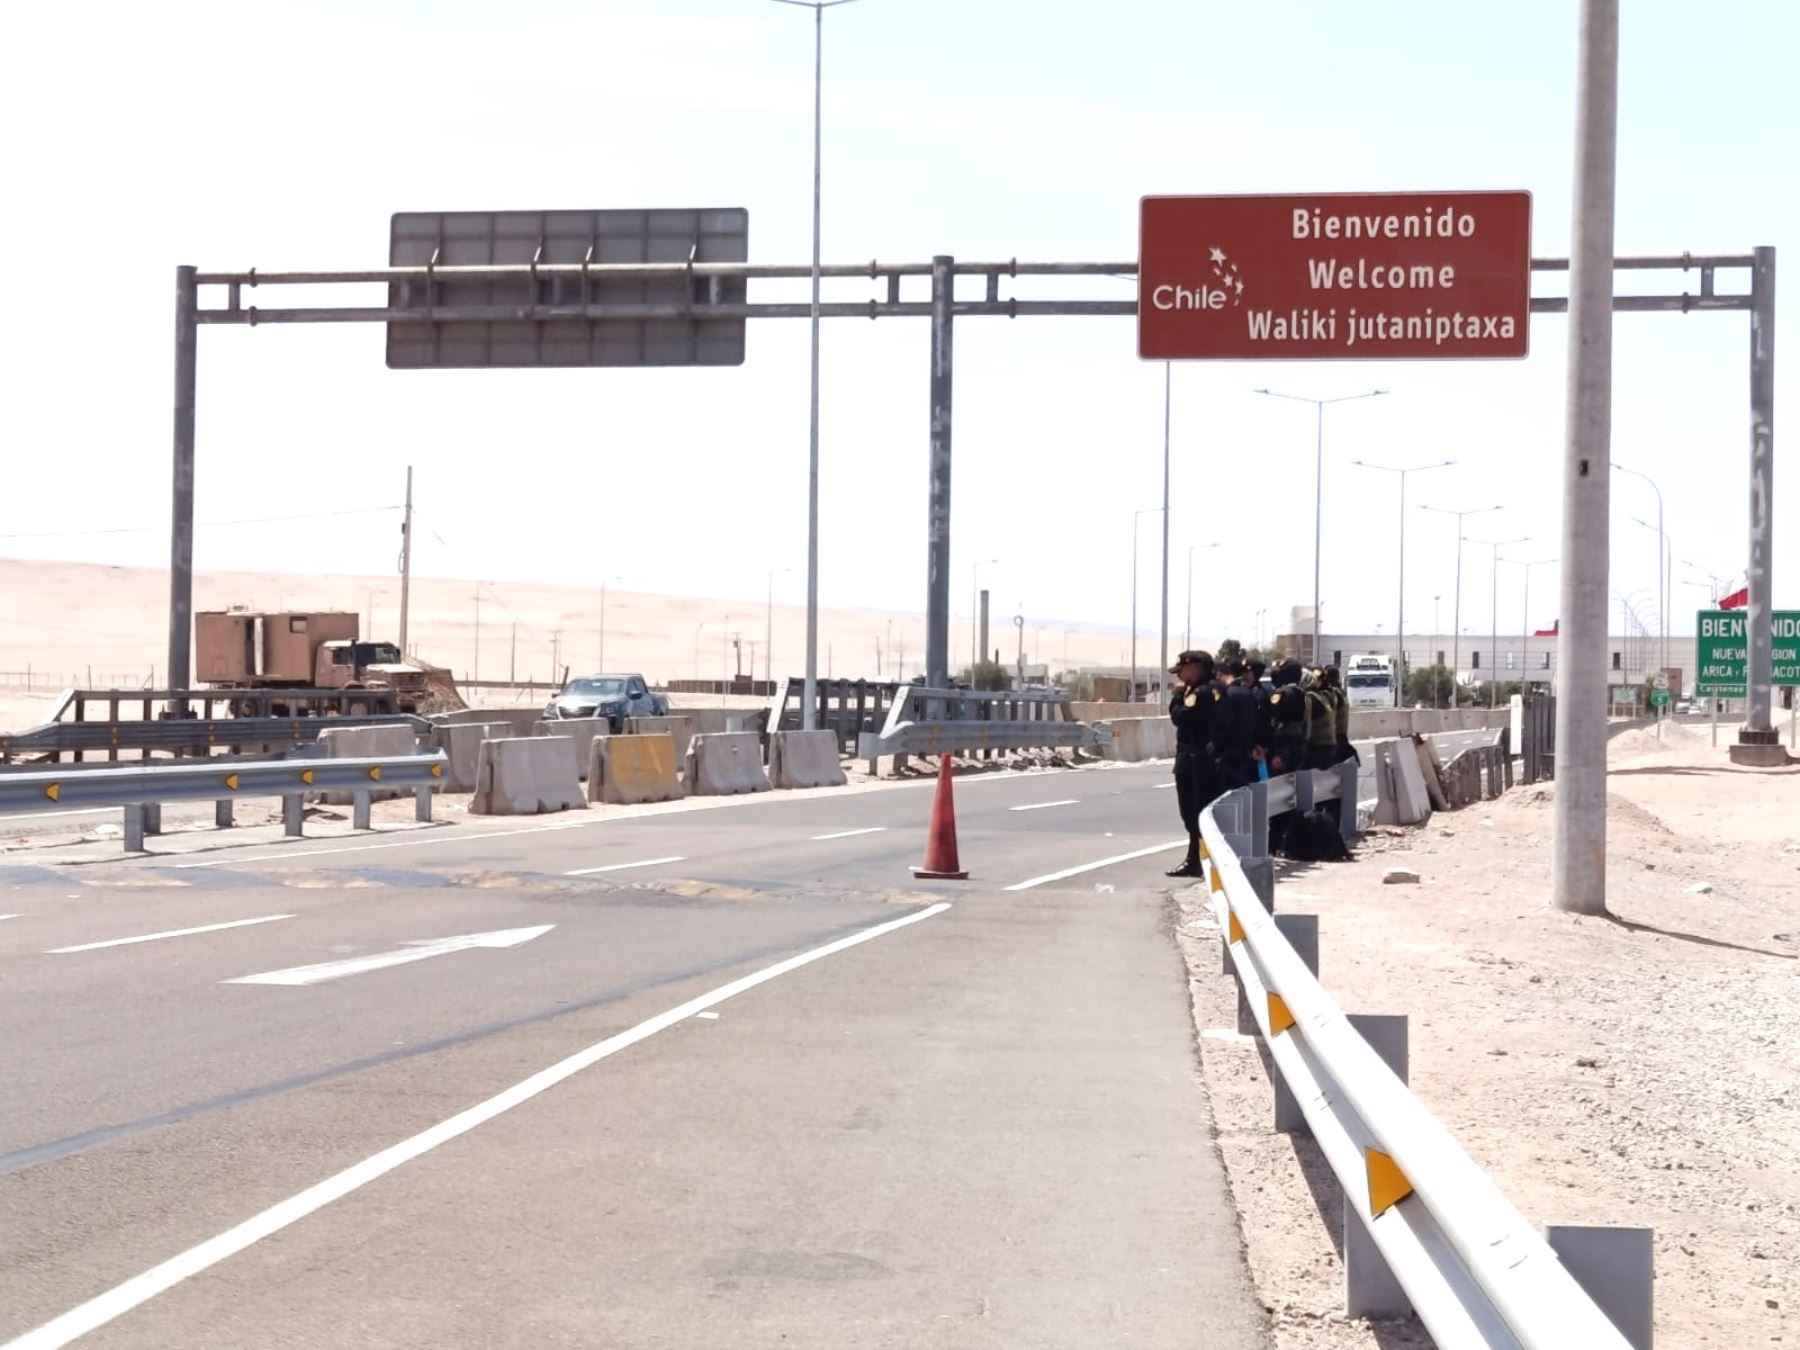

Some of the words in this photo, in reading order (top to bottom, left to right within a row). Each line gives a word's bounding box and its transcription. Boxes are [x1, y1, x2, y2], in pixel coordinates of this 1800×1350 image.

[1292, 207, 1476, 239] Bienvenido
[1308, 258, 1455, 290] Welcome
[1152, 285, 1226, 310] Chile
[1247, 310, 1337, 341] Waliki
[1346, 308, 1515, 346] jutaniptaxa
[1712, 648, 1747, 660] NUEVA
[1771, 649, 1797, 661] GION
[1702, 666, 1732, 677] ARICA
